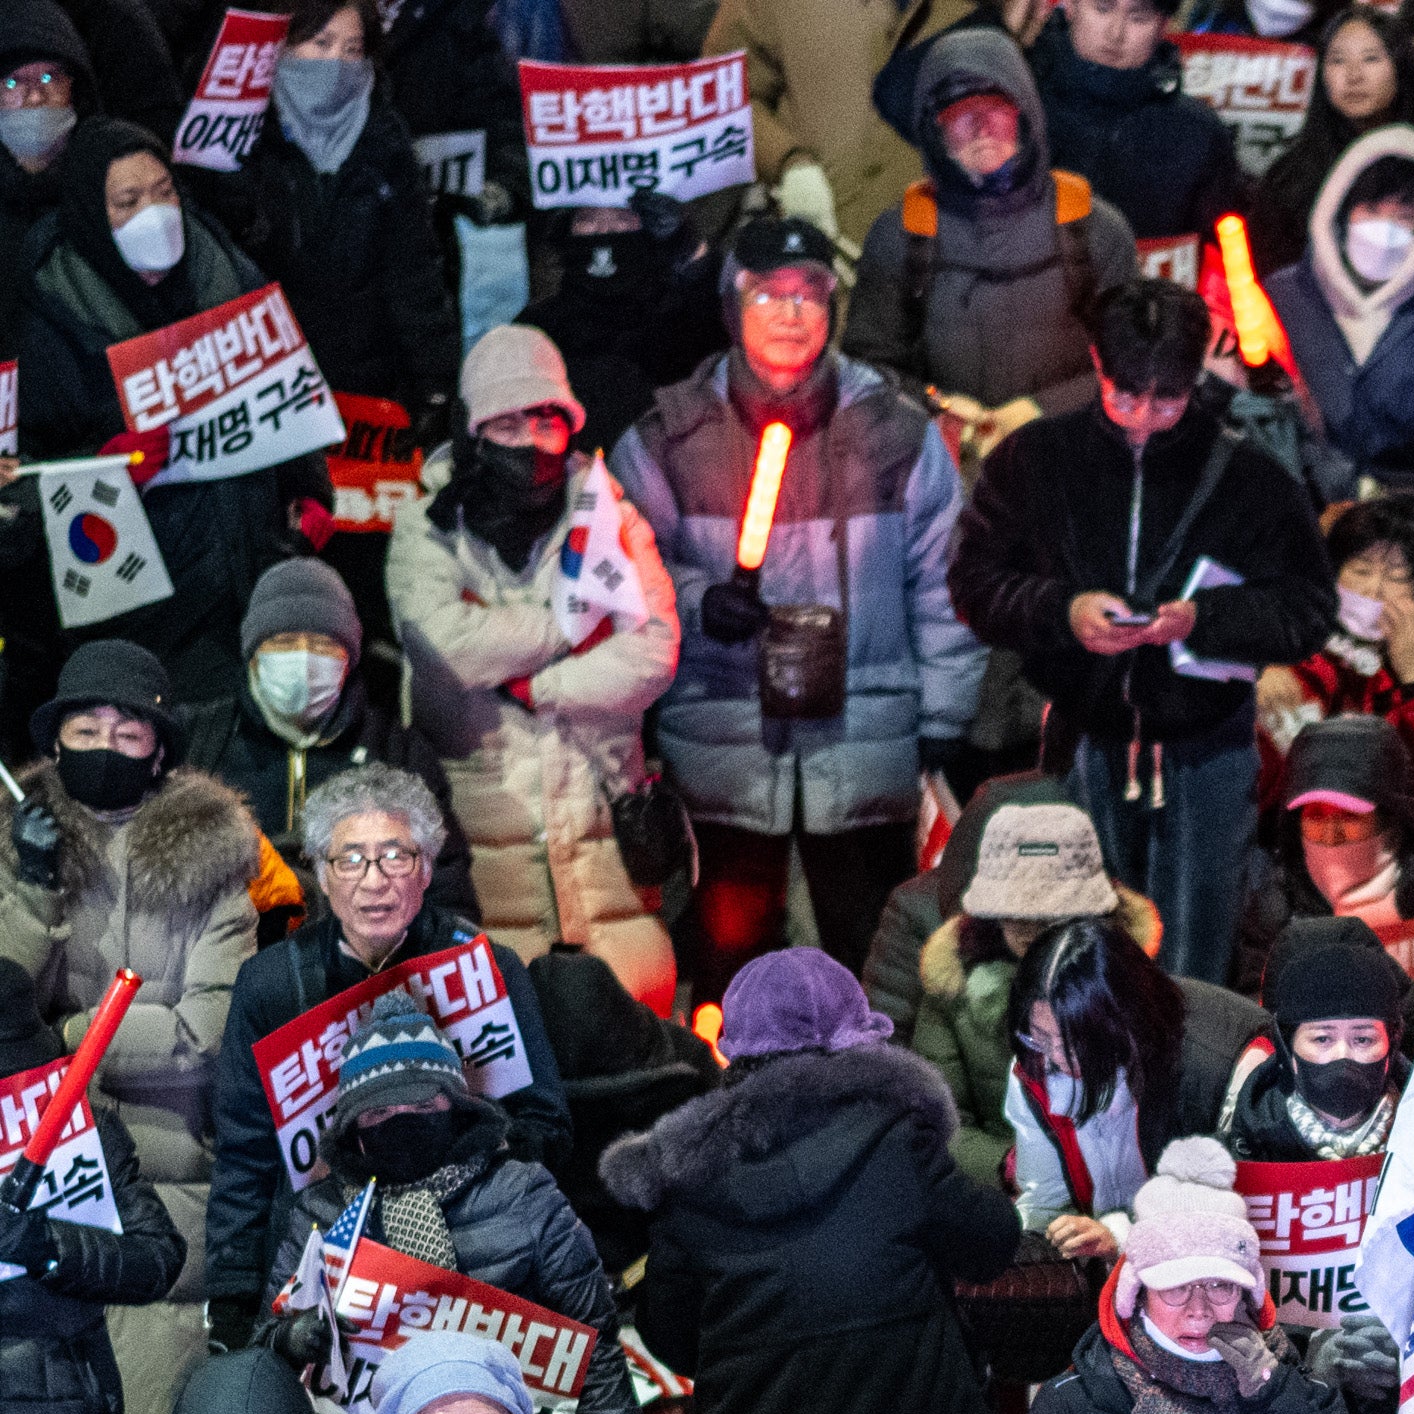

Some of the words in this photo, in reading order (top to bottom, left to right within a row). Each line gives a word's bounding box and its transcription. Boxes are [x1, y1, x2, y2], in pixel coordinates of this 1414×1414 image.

[531, 68, 744, 144] 탄핵반대
[537, 148, 661, 197] 이재명
[668, 125, 748, 178] 구속
[124, 290, 303, 431] 탄핵반대
[175, 402, 252, 463] 재명
[257, 370, 325, 432] 구속
[271, 949, 503, 1120] 탄대
[1247, 1178, 1379, 1253] 탄핵
